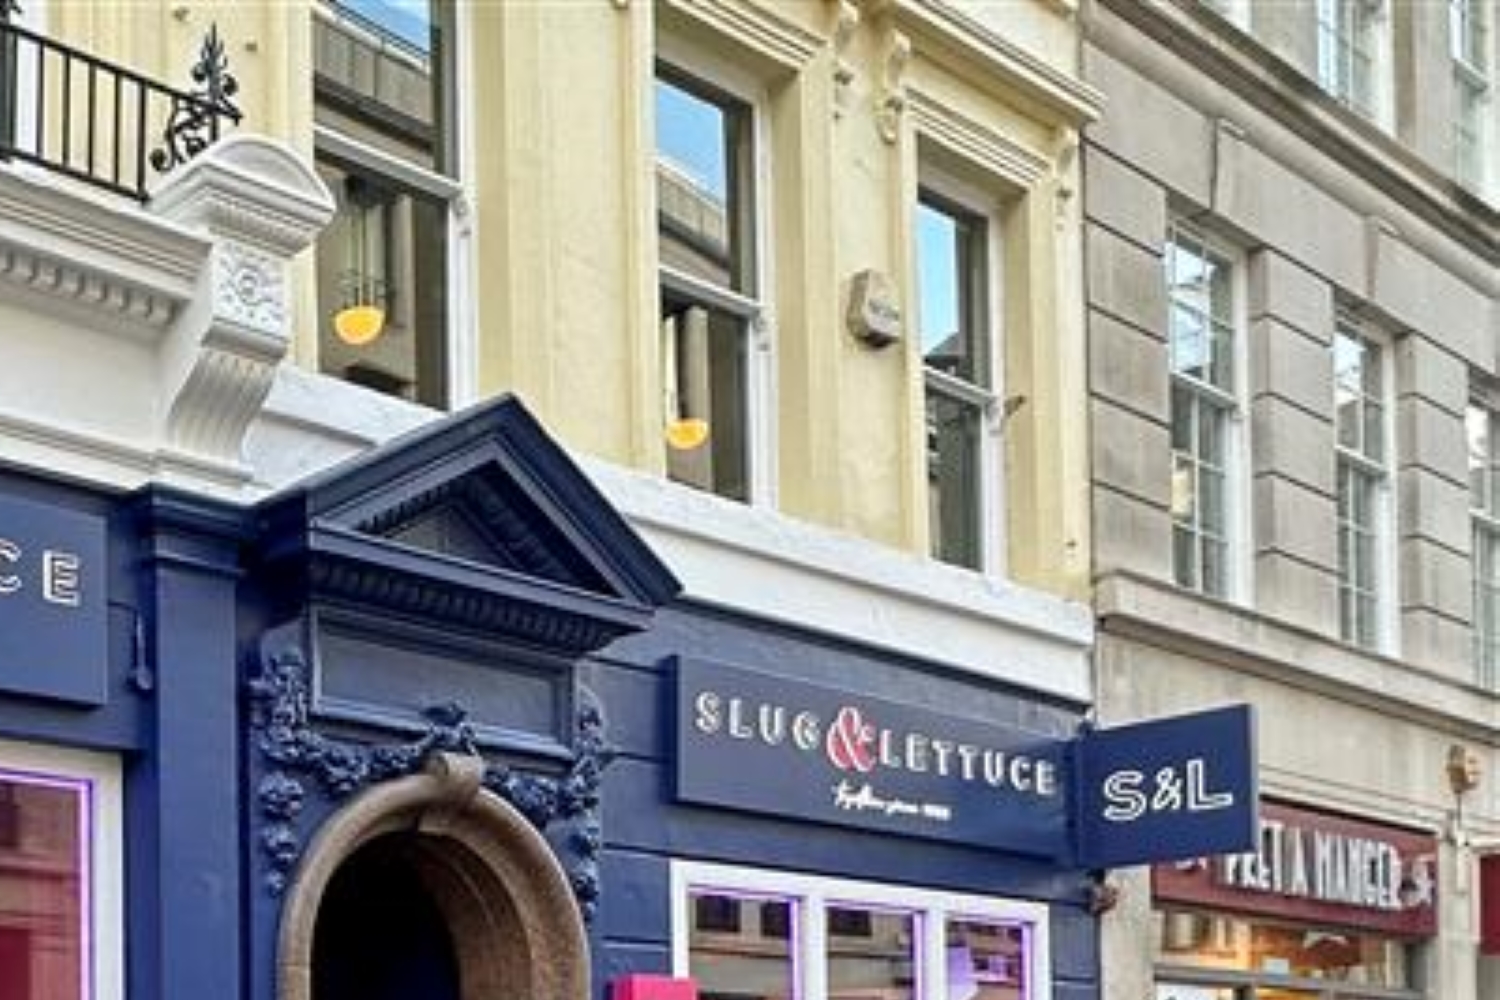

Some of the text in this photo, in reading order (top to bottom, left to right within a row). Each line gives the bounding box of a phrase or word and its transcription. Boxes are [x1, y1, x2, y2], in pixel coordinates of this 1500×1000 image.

[694, 690, 1059, 796] SLUG & LETTUCE
[1103, 758, 1234, 823] S&L
